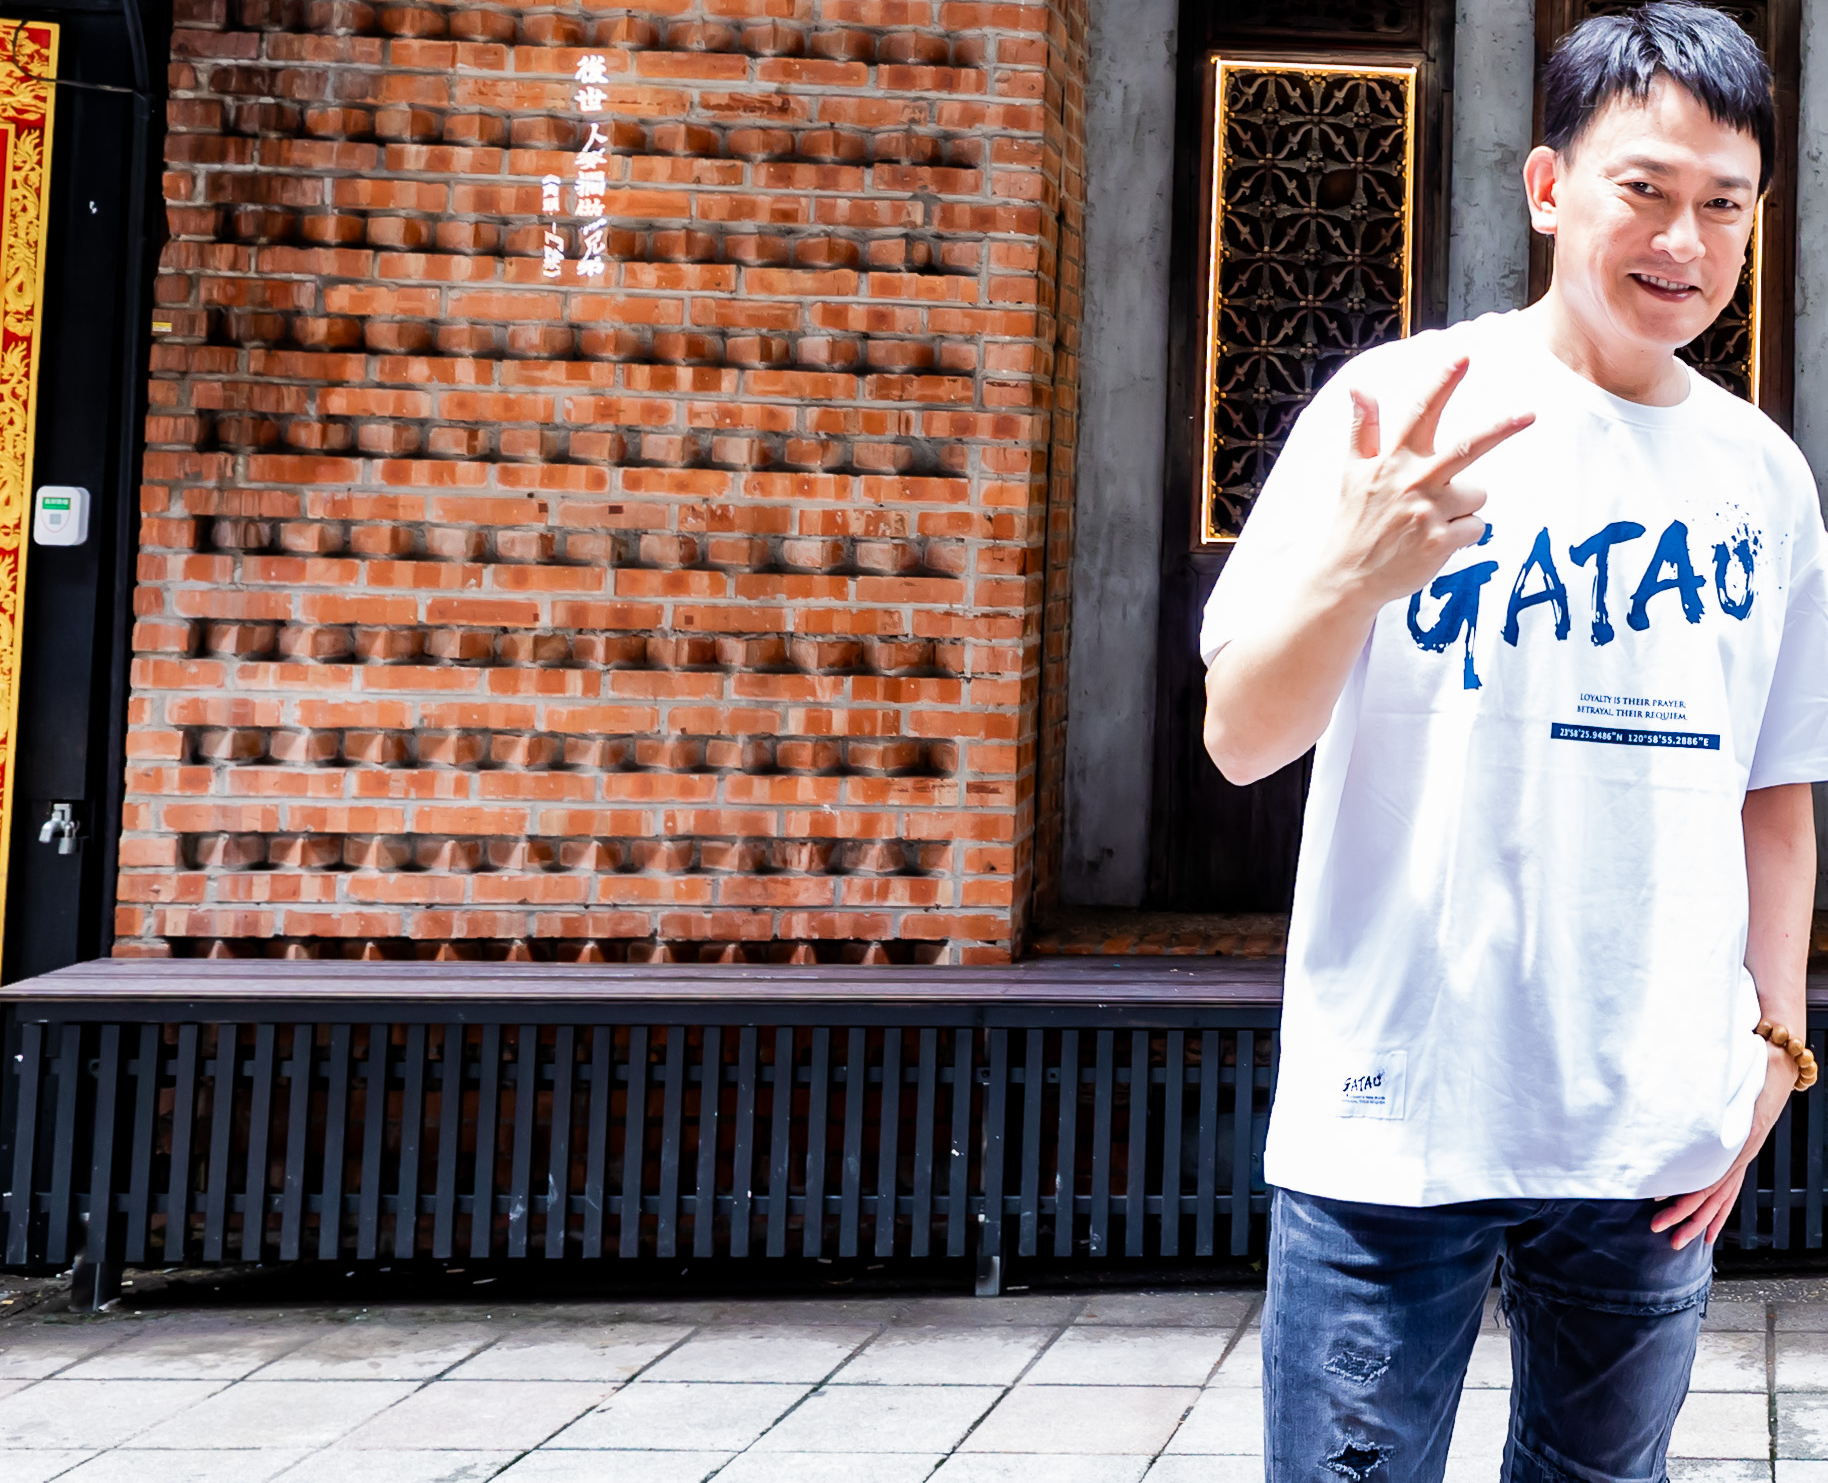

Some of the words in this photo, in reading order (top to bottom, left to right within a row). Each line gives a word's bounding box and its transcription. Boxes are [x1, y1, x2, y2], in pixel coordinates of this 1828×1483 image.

[1407, 518, 1760, 691] GATAO
[1580, 693, 1612, 704] LOYALTY
[1613, 696, 1621, 705] IS
[1622, 697, 1650, 707] THEIR
[1616, 709, 1643, 718] THEIR
